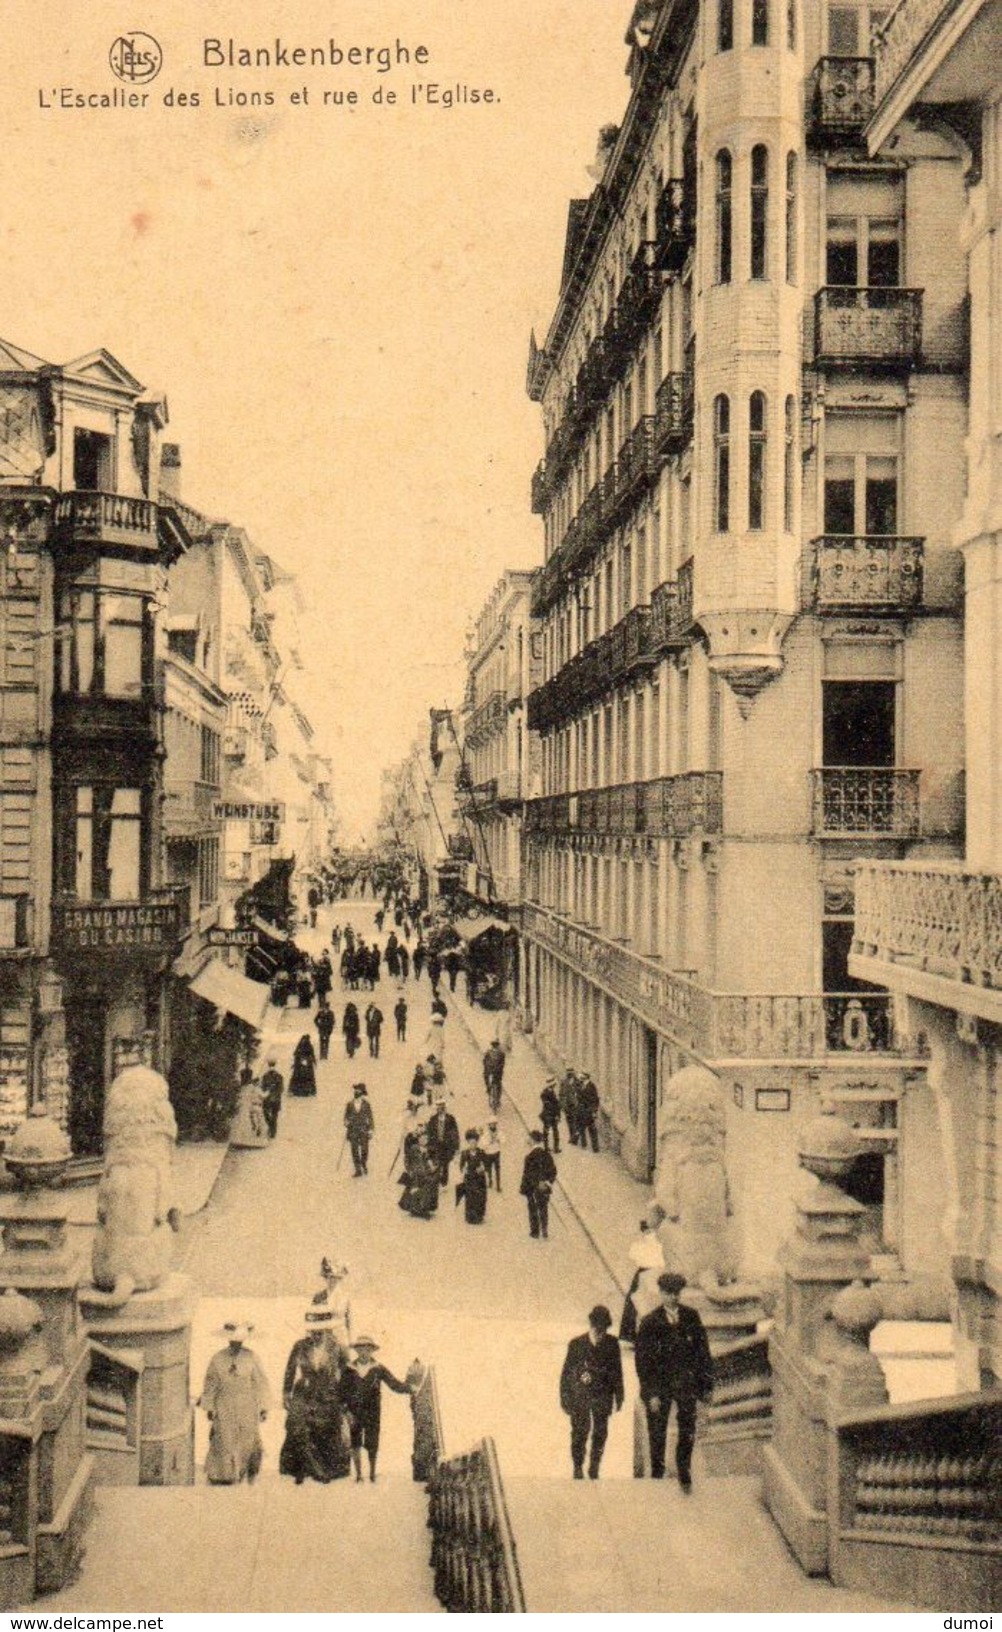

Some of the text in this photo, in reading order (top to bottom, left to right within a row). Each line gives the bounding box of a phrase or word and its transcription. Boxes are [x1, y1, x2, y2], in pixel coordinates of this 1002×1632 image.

[64, 907, 176, 930] GRAND MAGASIN
[104, 926, 162, 945] CASINO
